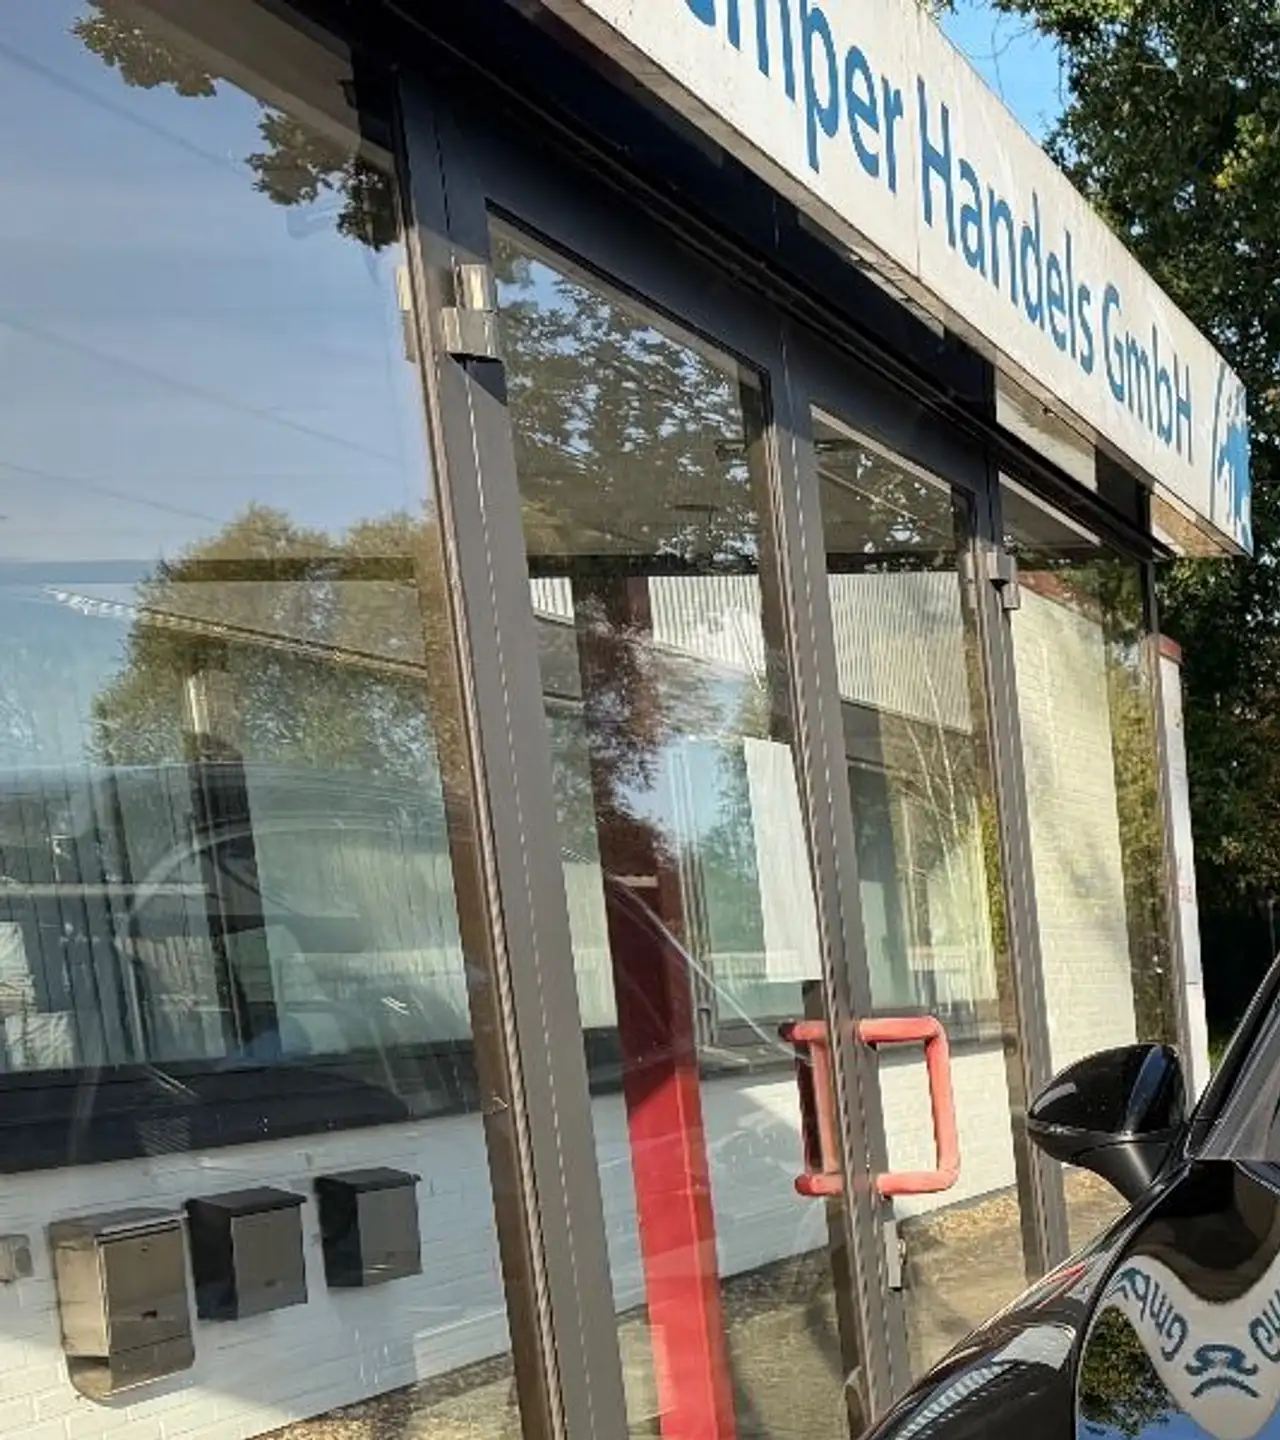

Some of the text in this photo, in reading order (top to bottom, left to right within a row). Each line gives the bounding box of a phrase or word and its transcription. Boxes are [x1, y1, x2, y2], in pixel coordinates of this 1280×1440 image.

[684, 0, 1194, 465] mper Handels GmbH
